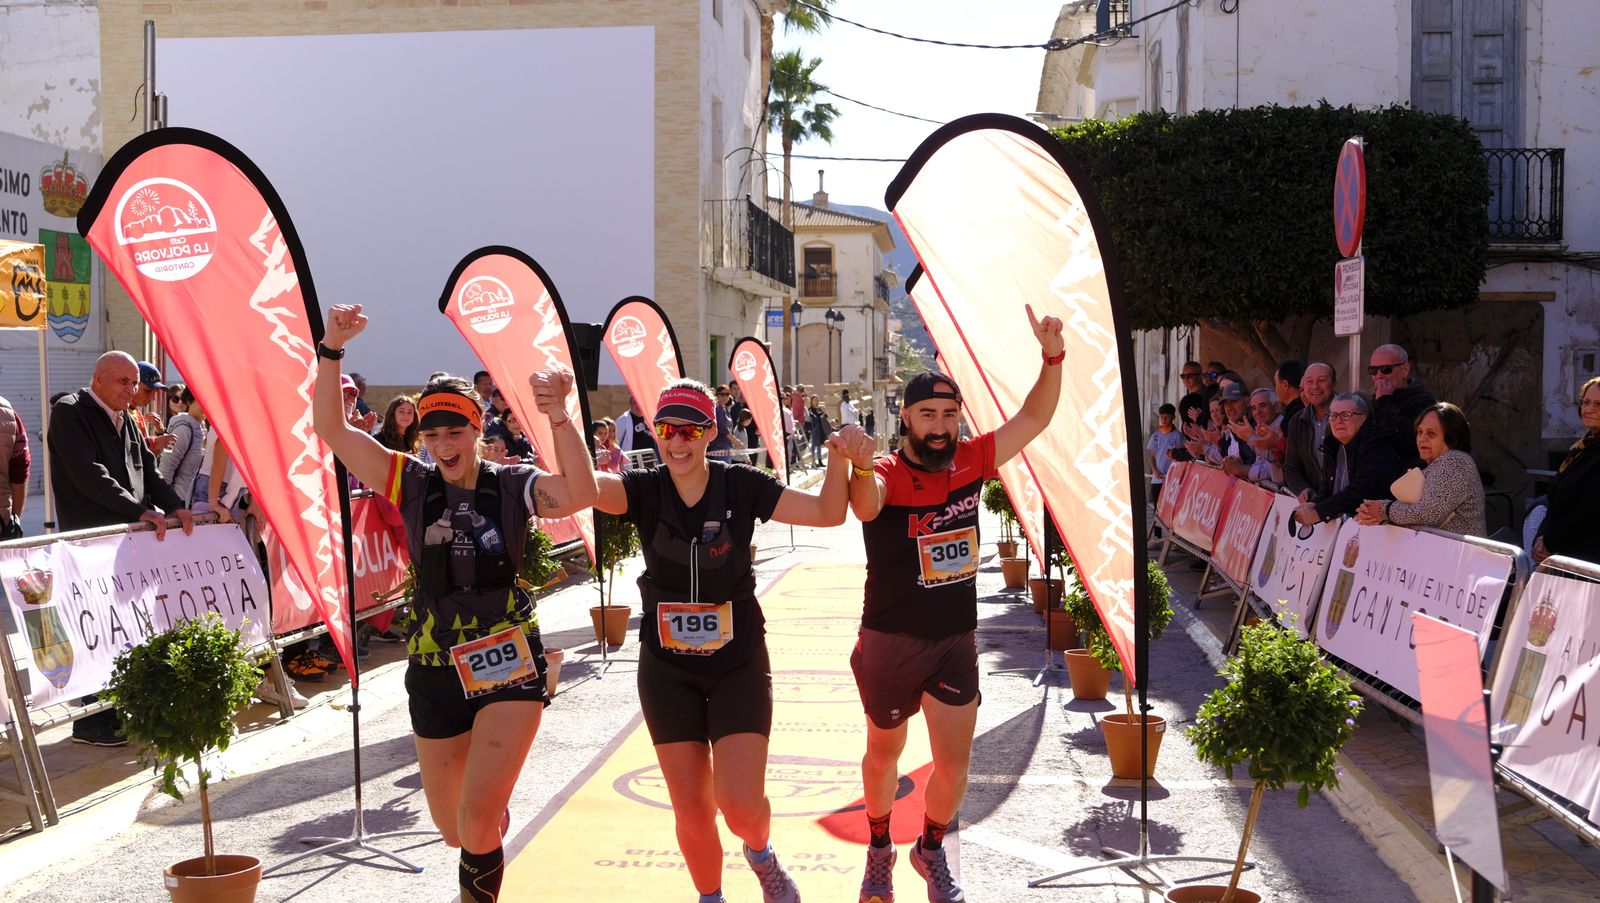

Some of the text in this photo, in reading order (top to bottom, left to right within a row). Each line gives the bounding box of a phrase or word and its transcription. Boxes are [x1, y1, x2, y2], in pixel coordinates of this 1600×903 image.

[0, 208, 28, 236] NTO
[352, 530, 399, 578] OLIA
[932, 541, 969, 563] 306
[72, 553, 245, 600] AYUNTAMIENTO DE
[1366, 559, 1487, 619] AYUNTAMIENTO DE
[79, 578, 257, 651] CANTORIA
[671, 614, 718, 632] 196
[468, 642, 518, 672] 209
